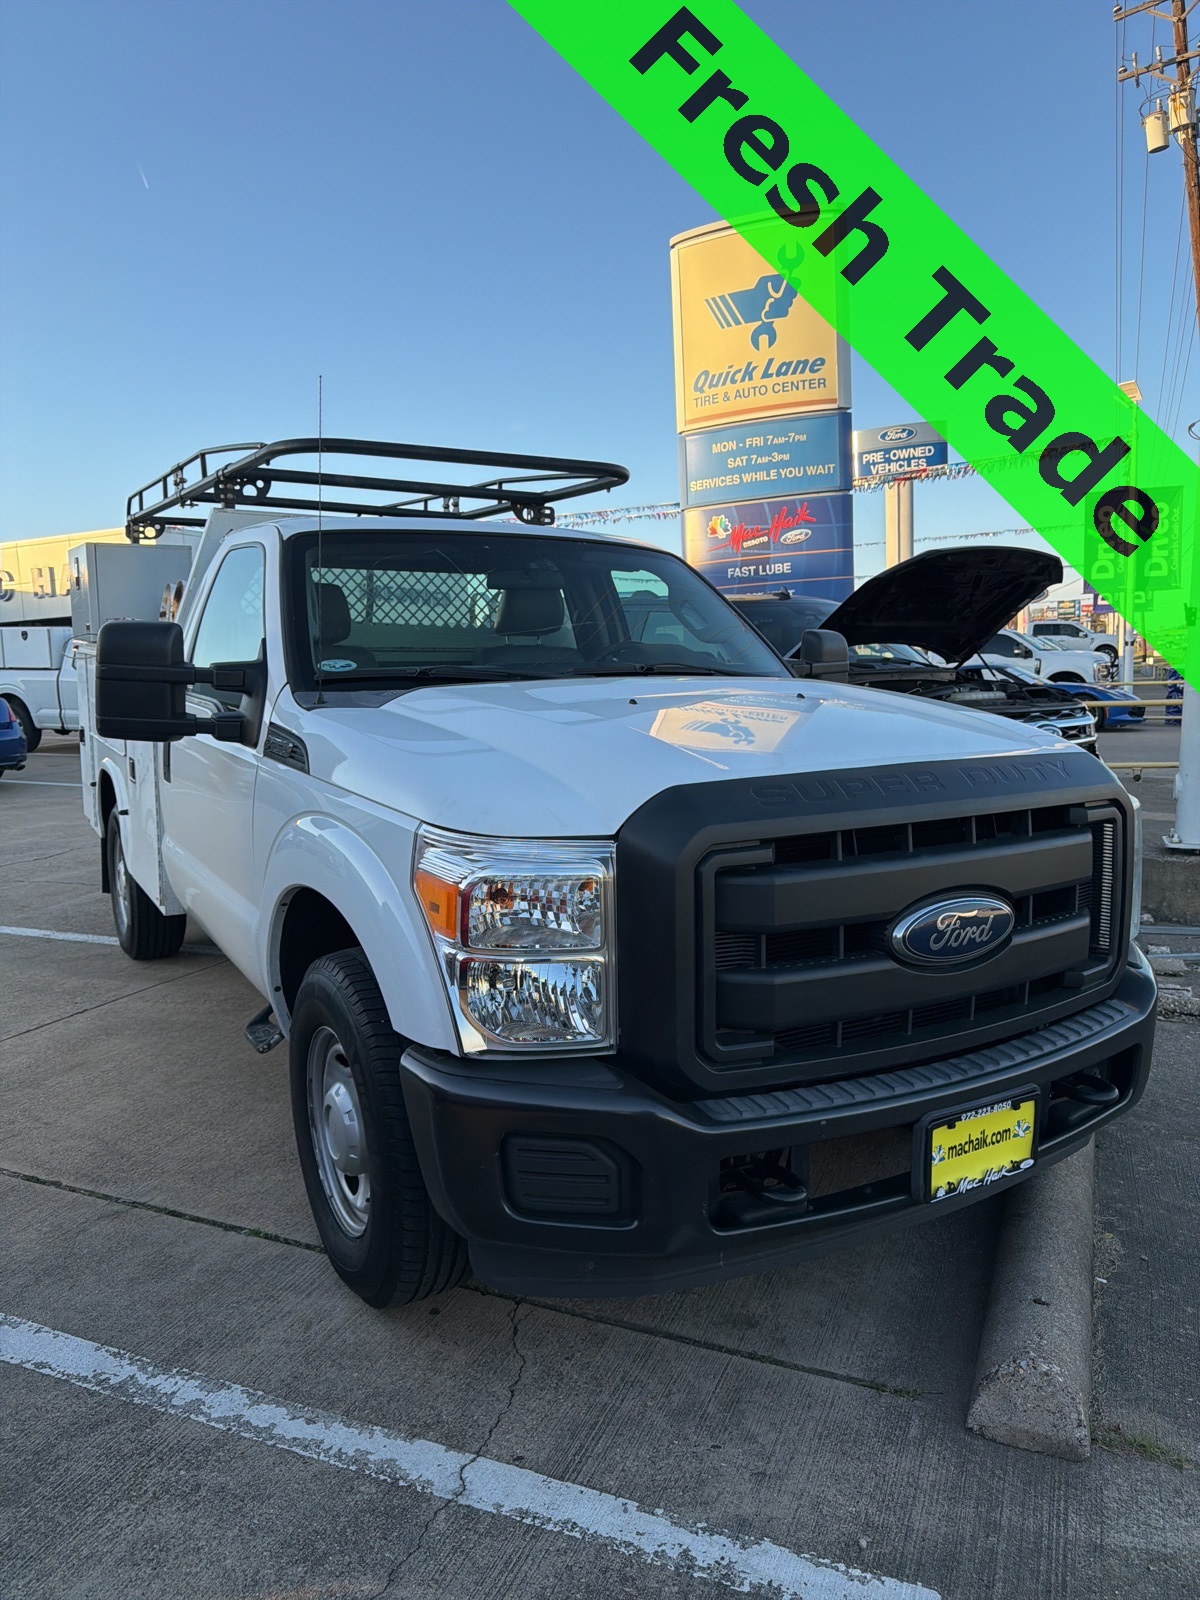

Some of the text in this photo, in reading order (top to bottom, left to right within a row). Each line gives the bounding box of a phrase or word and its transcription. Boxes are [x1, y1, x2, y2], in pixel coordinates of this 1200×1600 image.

[693, 356, 826, 394] Quick Lane
[693, 377, 827, 408] TIRE & AUTO CENTER
[712, 440, 737, 454] MON
[745, 436, 764, 448] FRI
[883, 427, 914, 442] Ford
[727, 455, 748, 468] SAT
[870, 458, 927, 475] VEHICLES
[689, 464, 836, 492] SERVICES WHILE YOU WAIT
[722, 501, 816, 553] Mac Haik
[742, 531, 808, 549] DESOTO Ford
[727, 562, 792, 579] FAST LUBE
[751, 759, 1072, 808] SUPER DUTY
[929, 907, 995, 951] Ford
[961, 1100, 1012, 1121] 972-223-8050
[947, 1128, 1011, 1160] machaik.com
[957, 1165, 1014, 1193] Mac Haik
